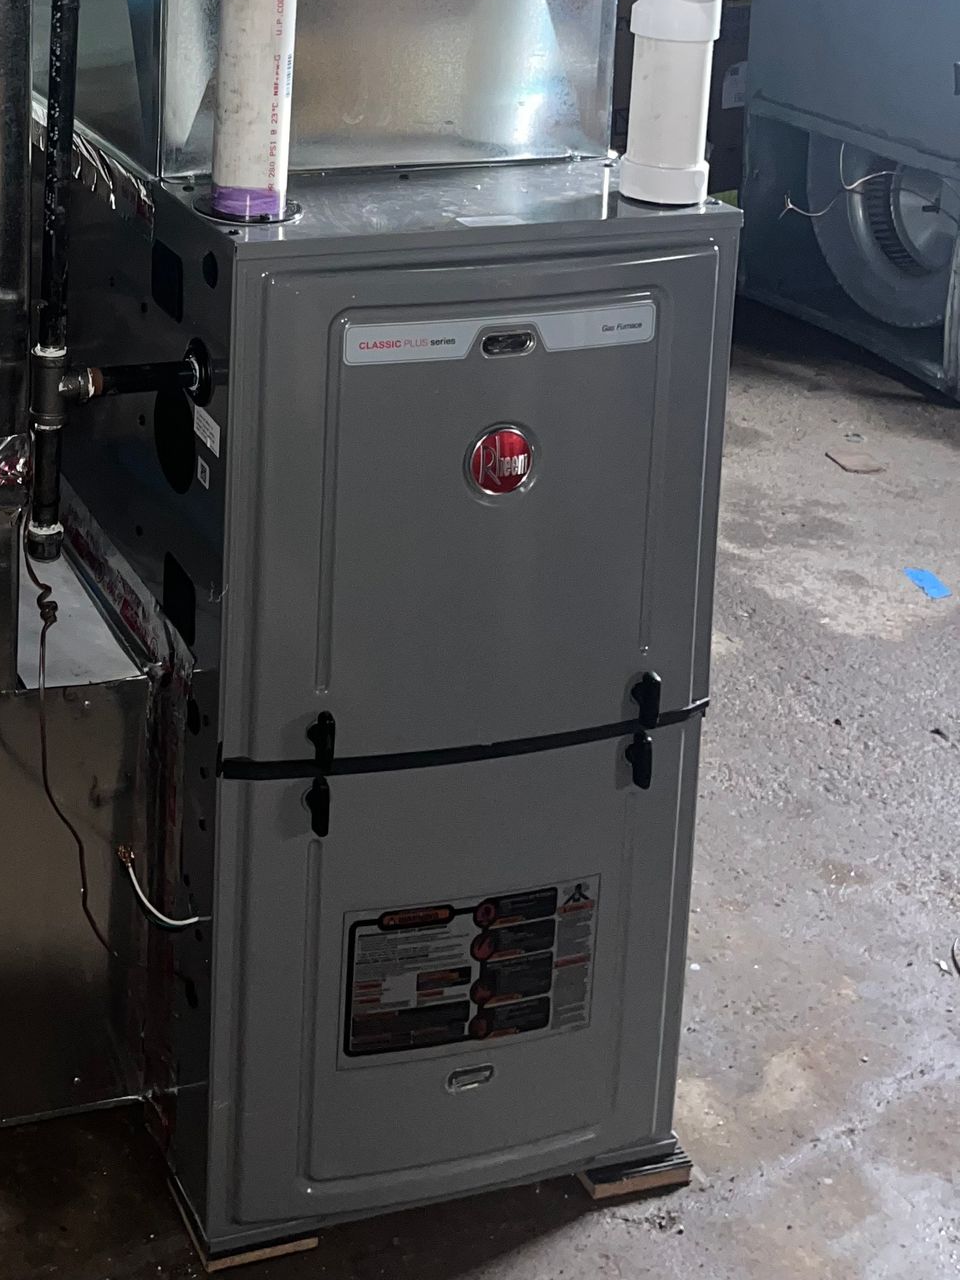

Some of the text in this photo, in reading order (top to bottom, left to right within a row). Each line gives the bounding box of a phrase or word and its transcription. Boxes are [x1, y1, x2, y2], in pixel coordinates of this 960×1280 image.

[358, 337, 456, 351] CLASSIC PLUS series
[478, 435, 528, 485] Rheem
